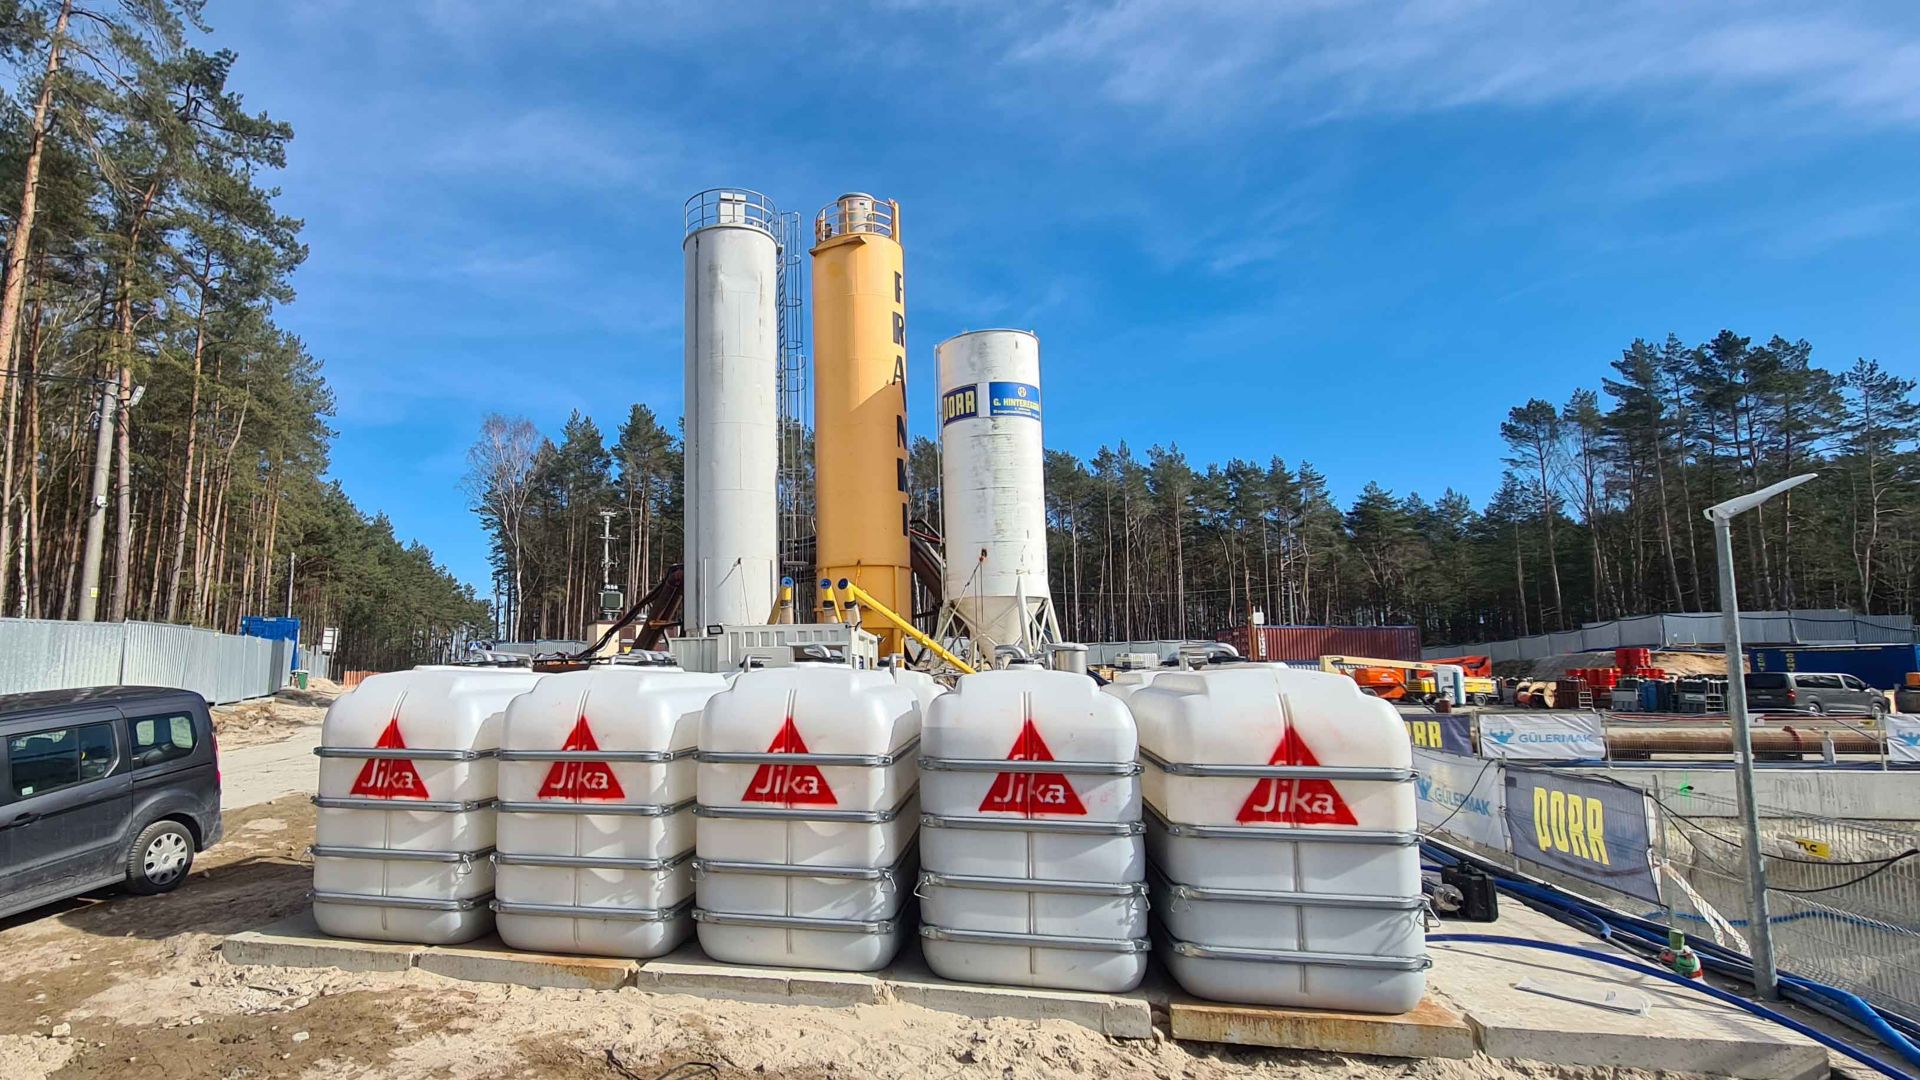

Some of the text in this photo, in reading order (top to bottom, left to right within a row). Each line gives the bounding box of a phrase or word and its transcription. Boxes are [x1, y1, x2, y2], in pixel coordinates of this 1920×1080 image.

[891, 270, 909, 537] FRANKI
[1518, 731, 1593, 743] GÜLERMAK
[1533, 786, 1610, 866] PORR
